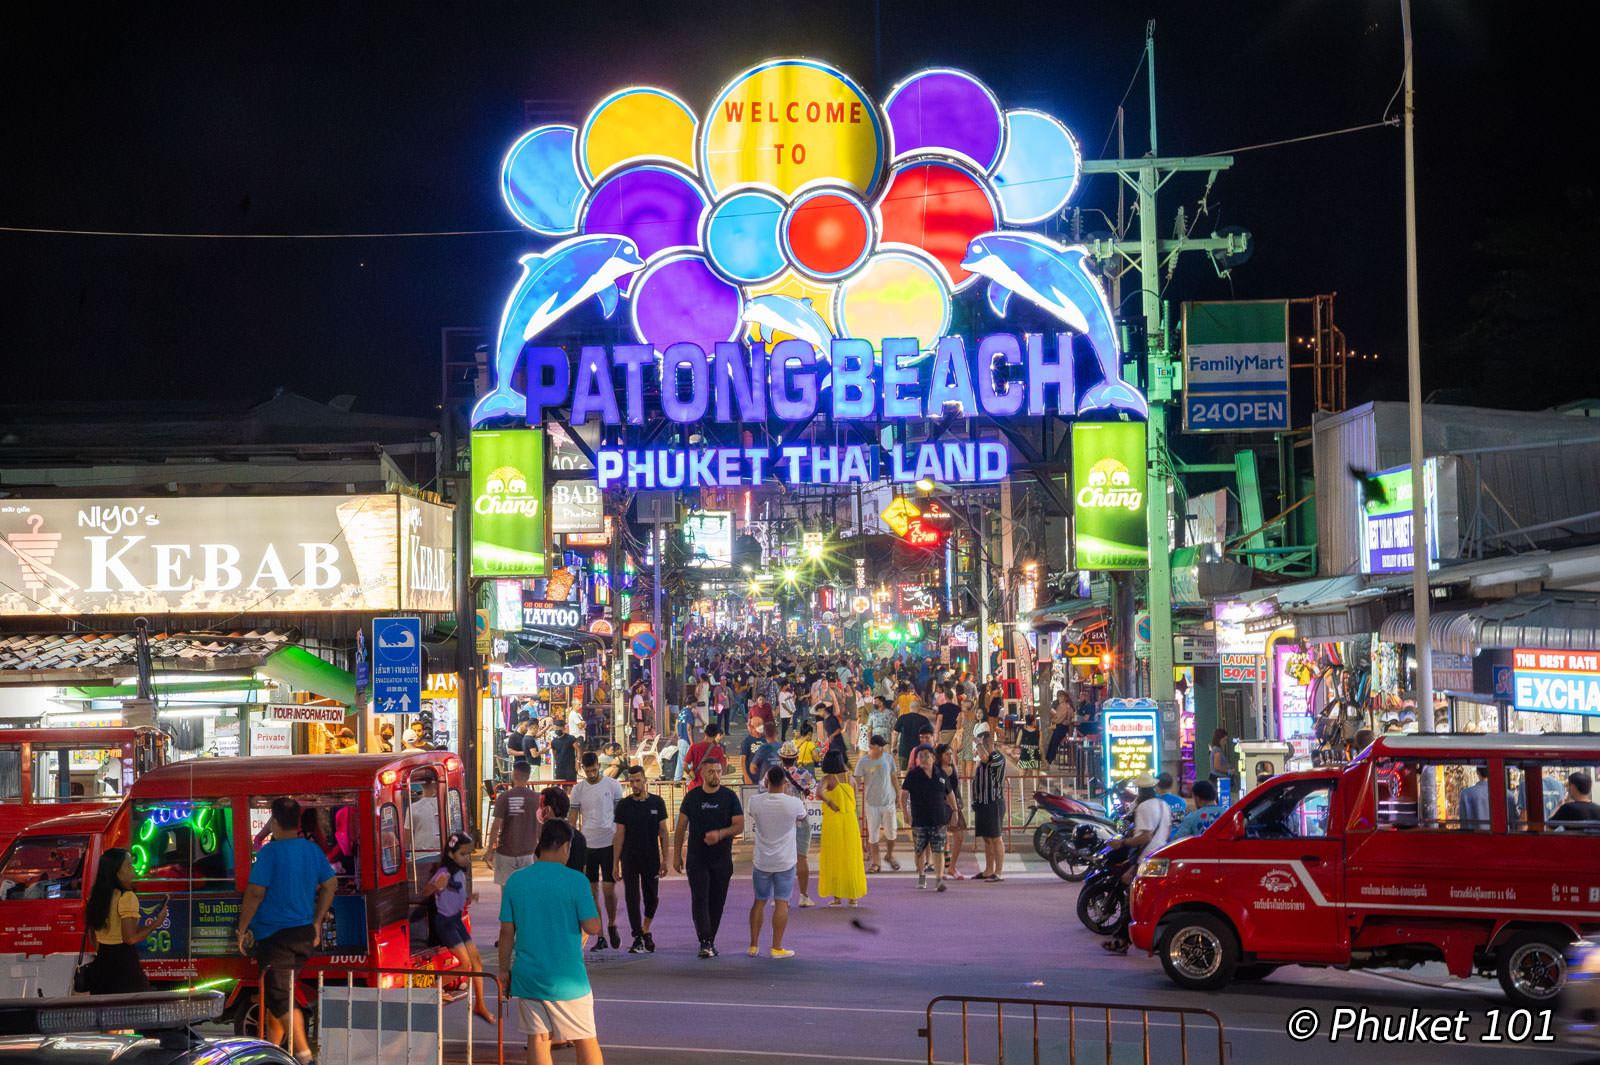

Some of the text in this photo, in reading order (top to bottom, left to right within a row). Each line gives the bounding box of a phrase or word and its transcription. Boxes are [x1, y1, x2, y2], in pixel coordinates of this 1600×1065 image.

[725, 101, 861, 124] WELCOME
[773, 143, 806, 165] TO
[1189, 355, 1284, 375] FamilyMart
[525, 332, 1076, 426] PATONG BEACH
[597, 448, 768, 488] PHUKET
[474, 494, 538, 518] Chang
[1077, 486, 1143, 511] Chang
[84, 535, 342, 593] KEBAB
[523, 608, 579, 627] TATTOO
[1515, 653, 1598, 670] THE BEST RATE
[273, 706, 343, 721] TOUR INFORMATION
[256, 733, 286, 742] Private
[146, 930, 172, 952] 5G
